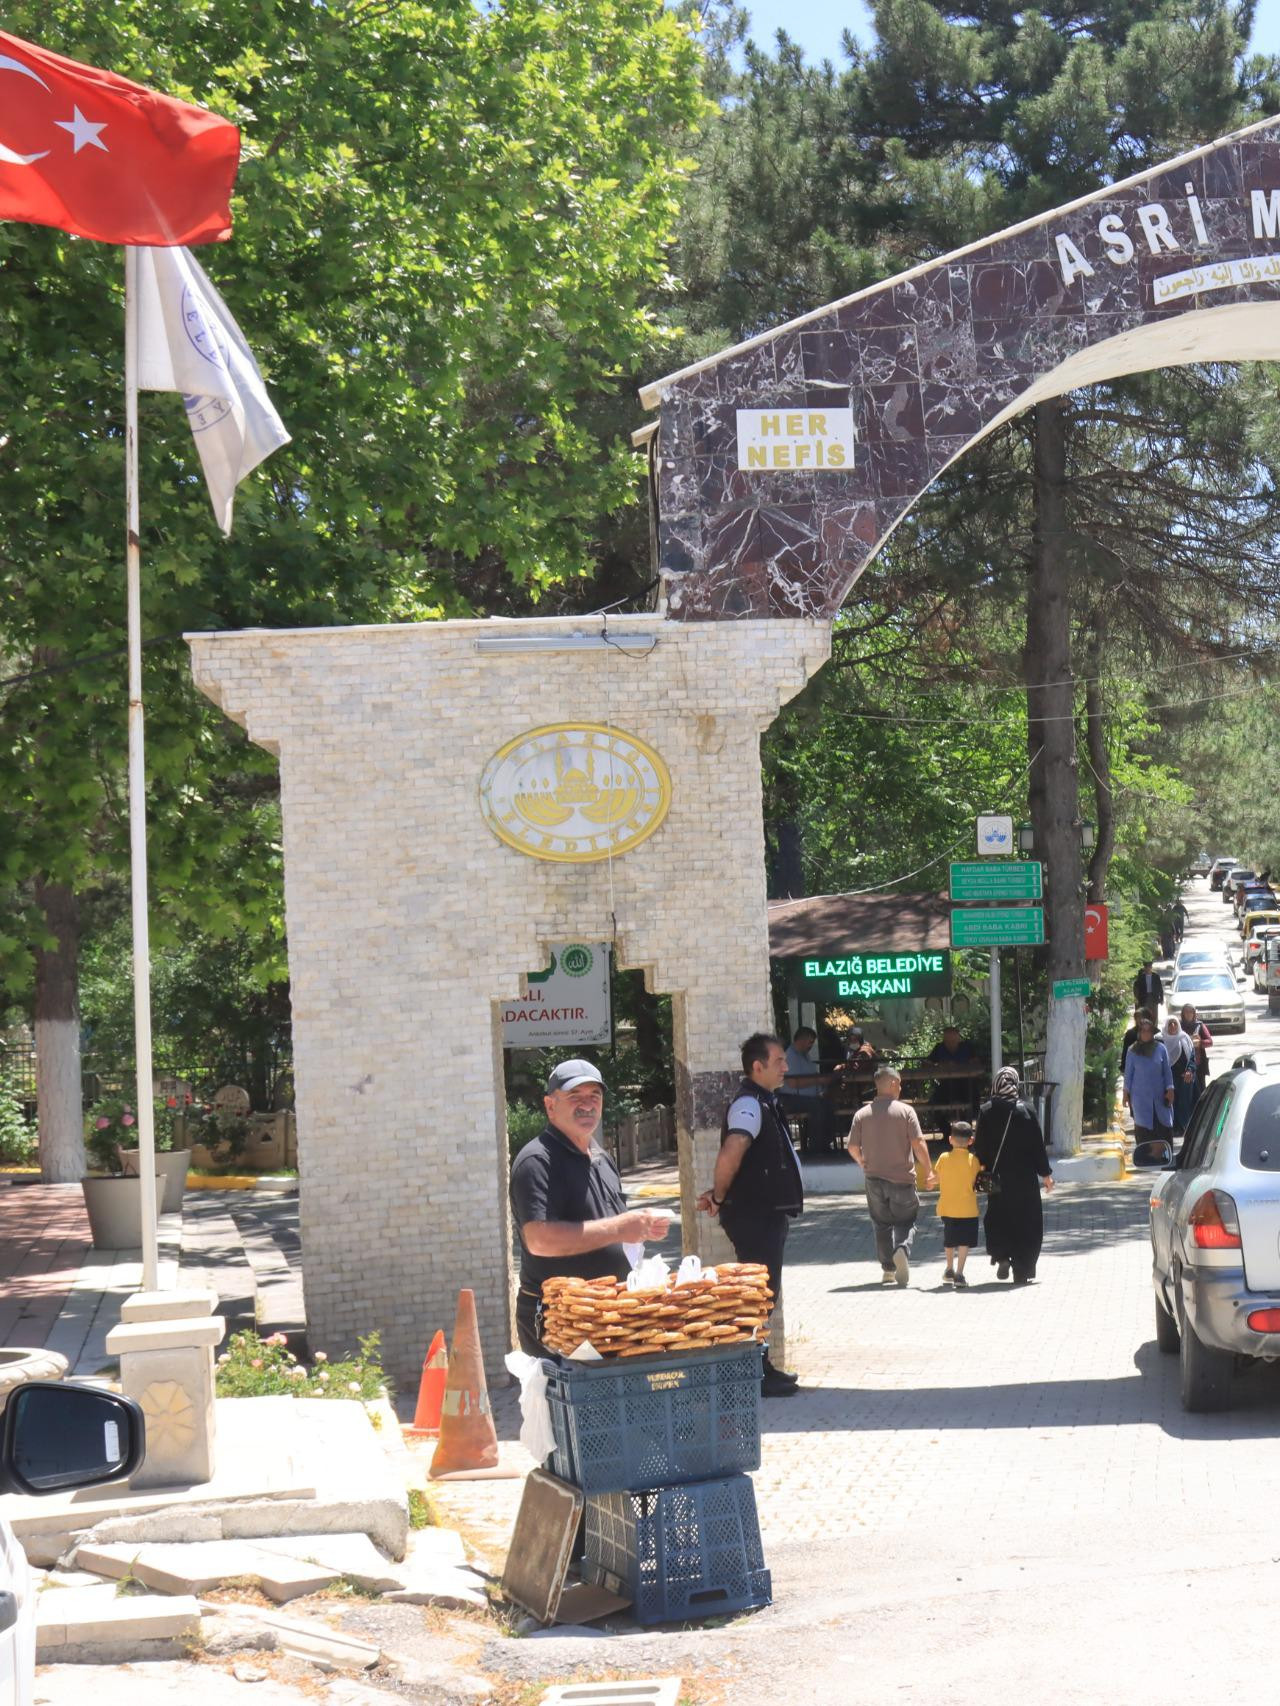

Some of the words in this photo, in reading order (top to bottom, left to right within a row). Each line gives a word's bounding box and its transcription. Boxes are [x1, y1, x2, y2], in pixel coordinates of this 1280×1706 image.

[1054, 182, 1210, 287] ASRİ
[761, 414, 828, 436] HER
[804, 956, 863, 977] ELAZIĞ
[866, 954, 943, 974] BELEDİYE
[838, 978, 911, 998] BAŞKANI
